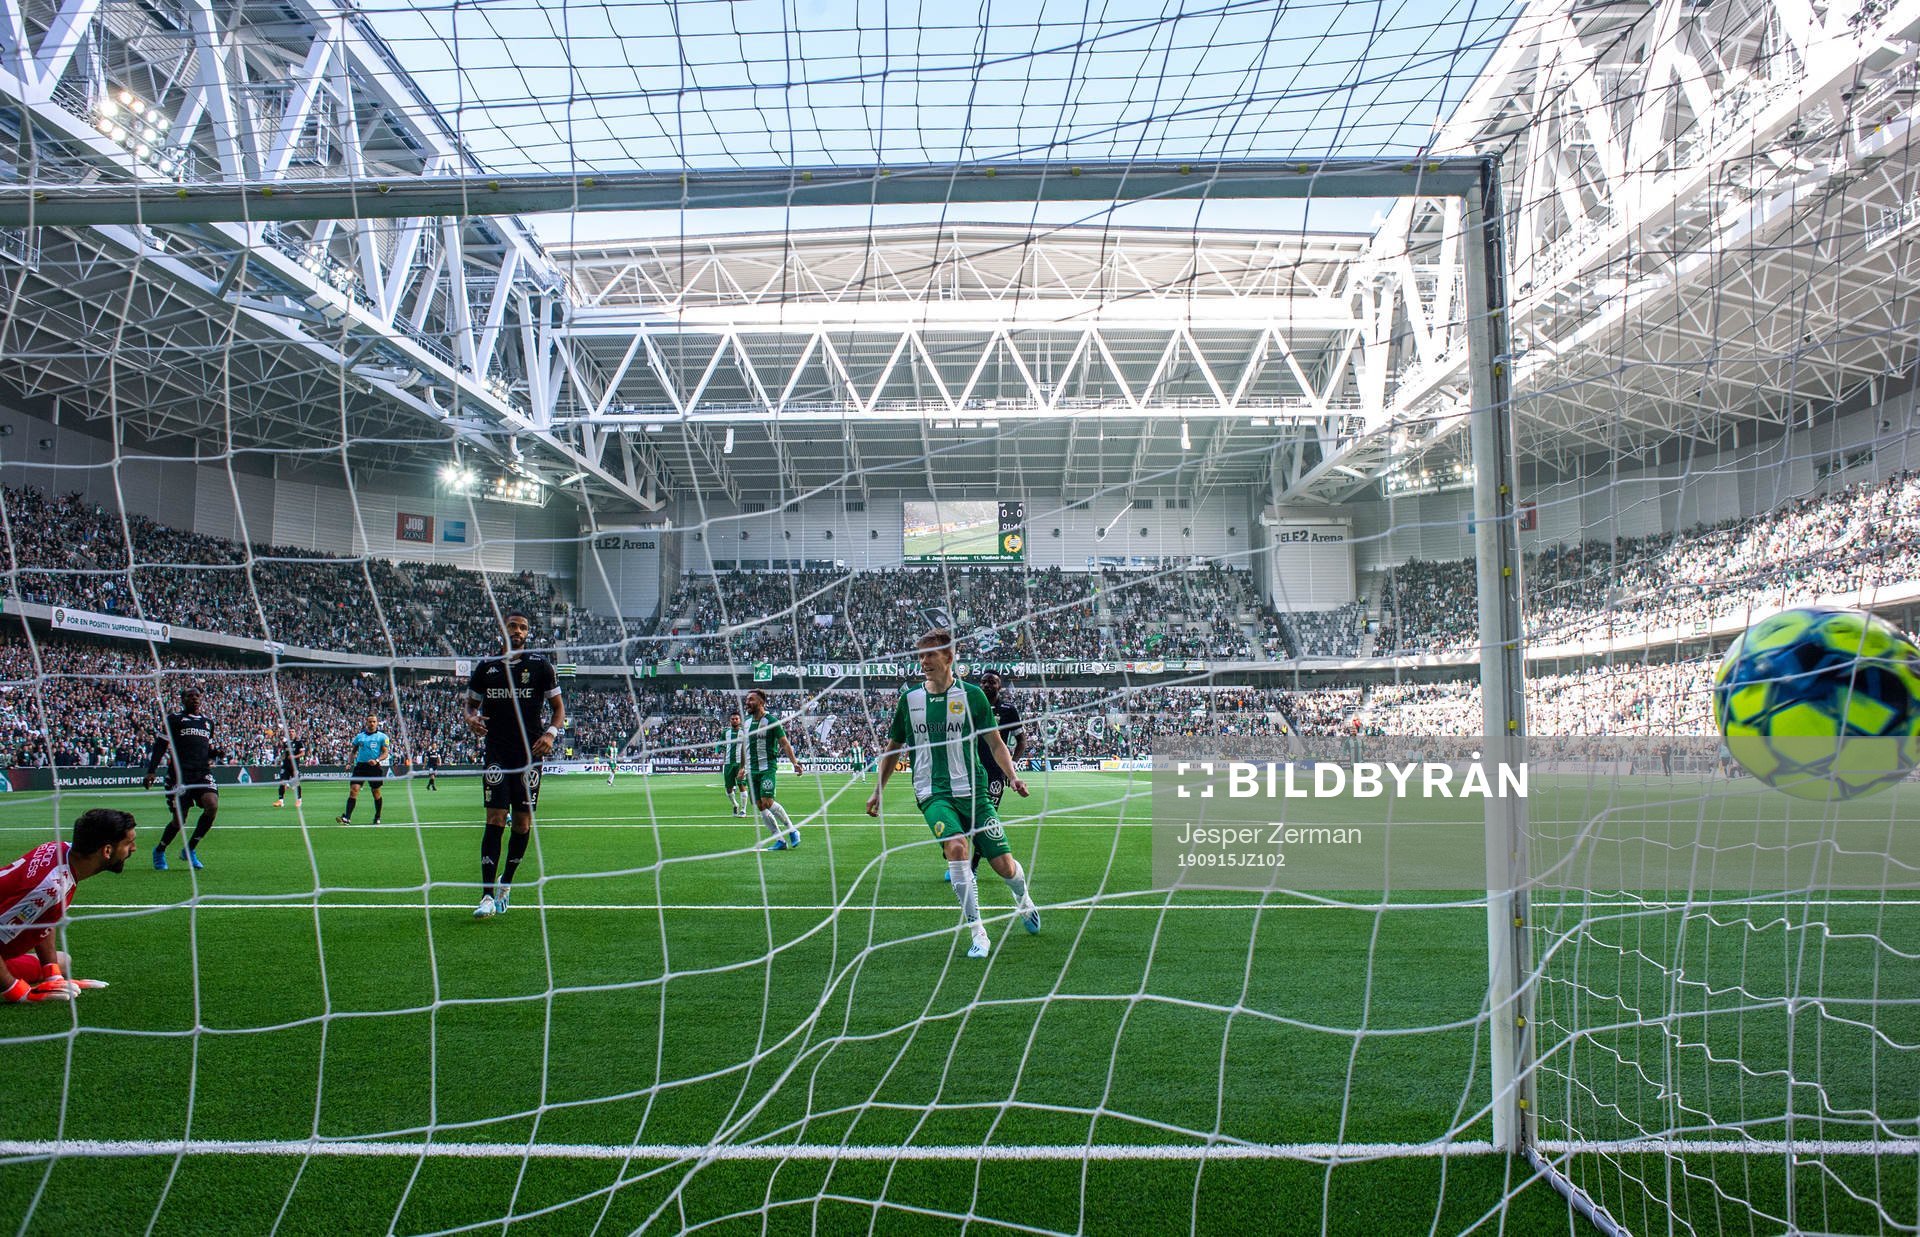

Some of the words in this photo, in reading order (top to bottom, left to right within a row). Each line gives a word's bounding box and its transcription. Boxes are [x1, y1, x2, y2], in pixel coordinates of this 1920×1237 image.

[1001, 509, 1008, 518] 0
[1016, 509, 1023, 518] 0
[406, 517, 424, 531] JOB
[404, 530, 426, 540] ZONE
[1311, 533, 1344, 543] Arena
[622, 540, 655, 550] Arena
[801, 763, 855, 771] METODGOL
[103, 777, 117, 785] OCH
